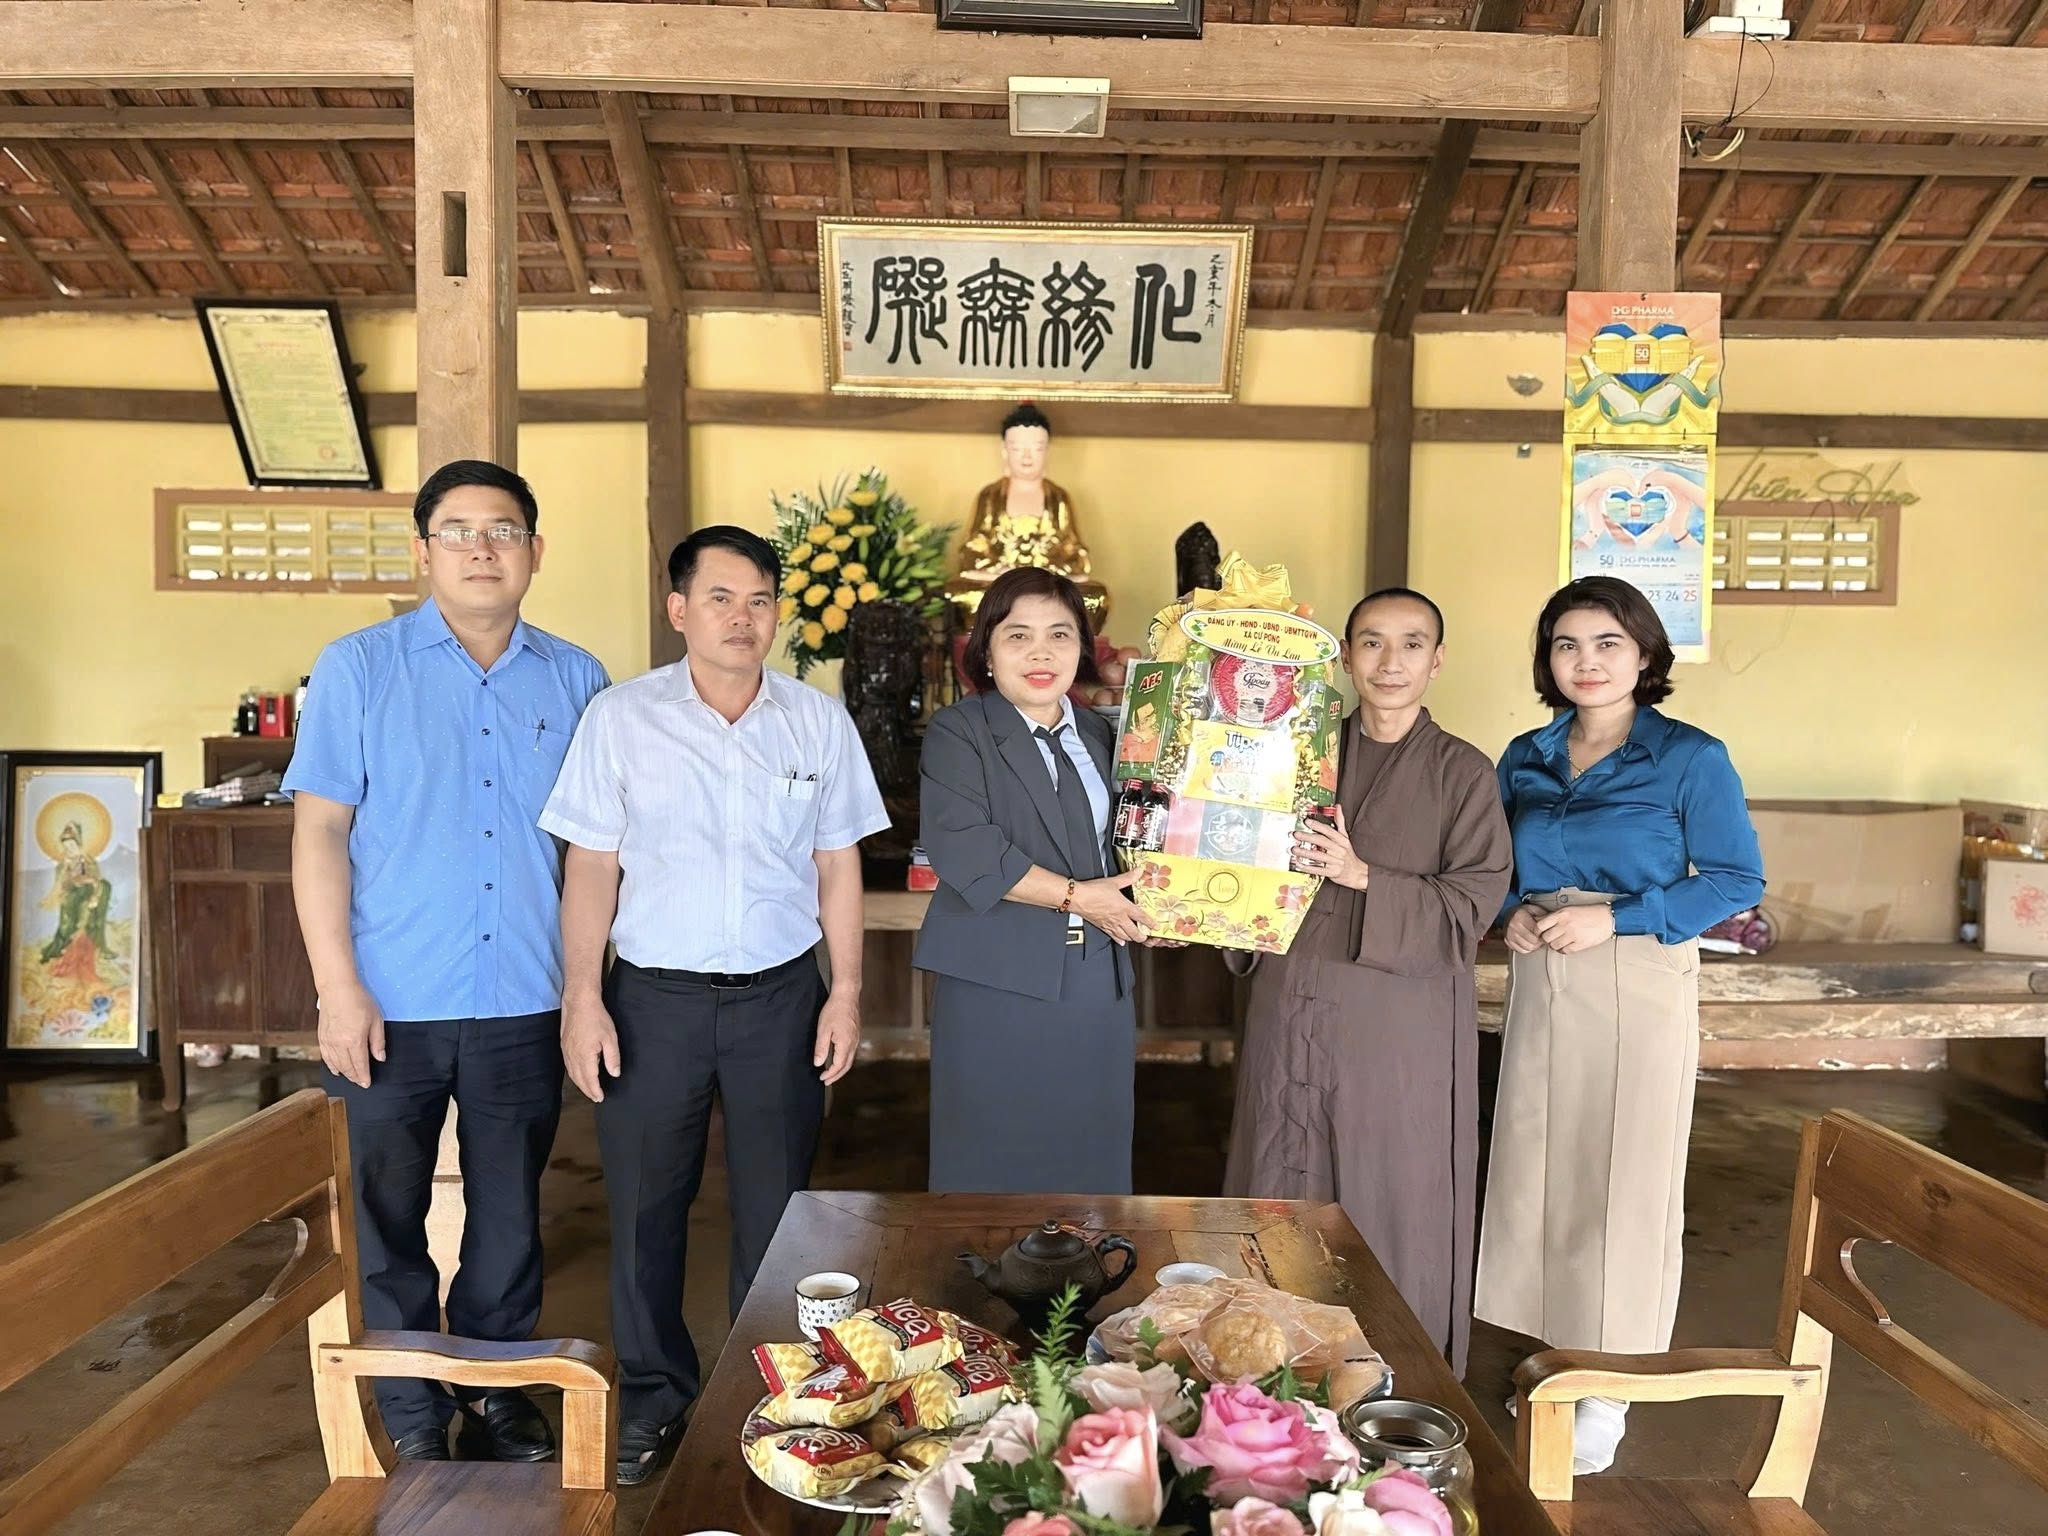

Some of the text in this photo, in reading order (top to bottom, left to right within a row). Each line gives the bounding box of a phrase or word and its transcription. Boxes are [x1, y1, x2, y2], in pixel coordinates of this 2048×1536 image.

[1632, 306, 1674, 315] PHARMA
[1600, 554, 1614, 566] 50
[1647, 590, 1698, 602] 23 24 25
[1263, 621, 1280, 632] UBND
